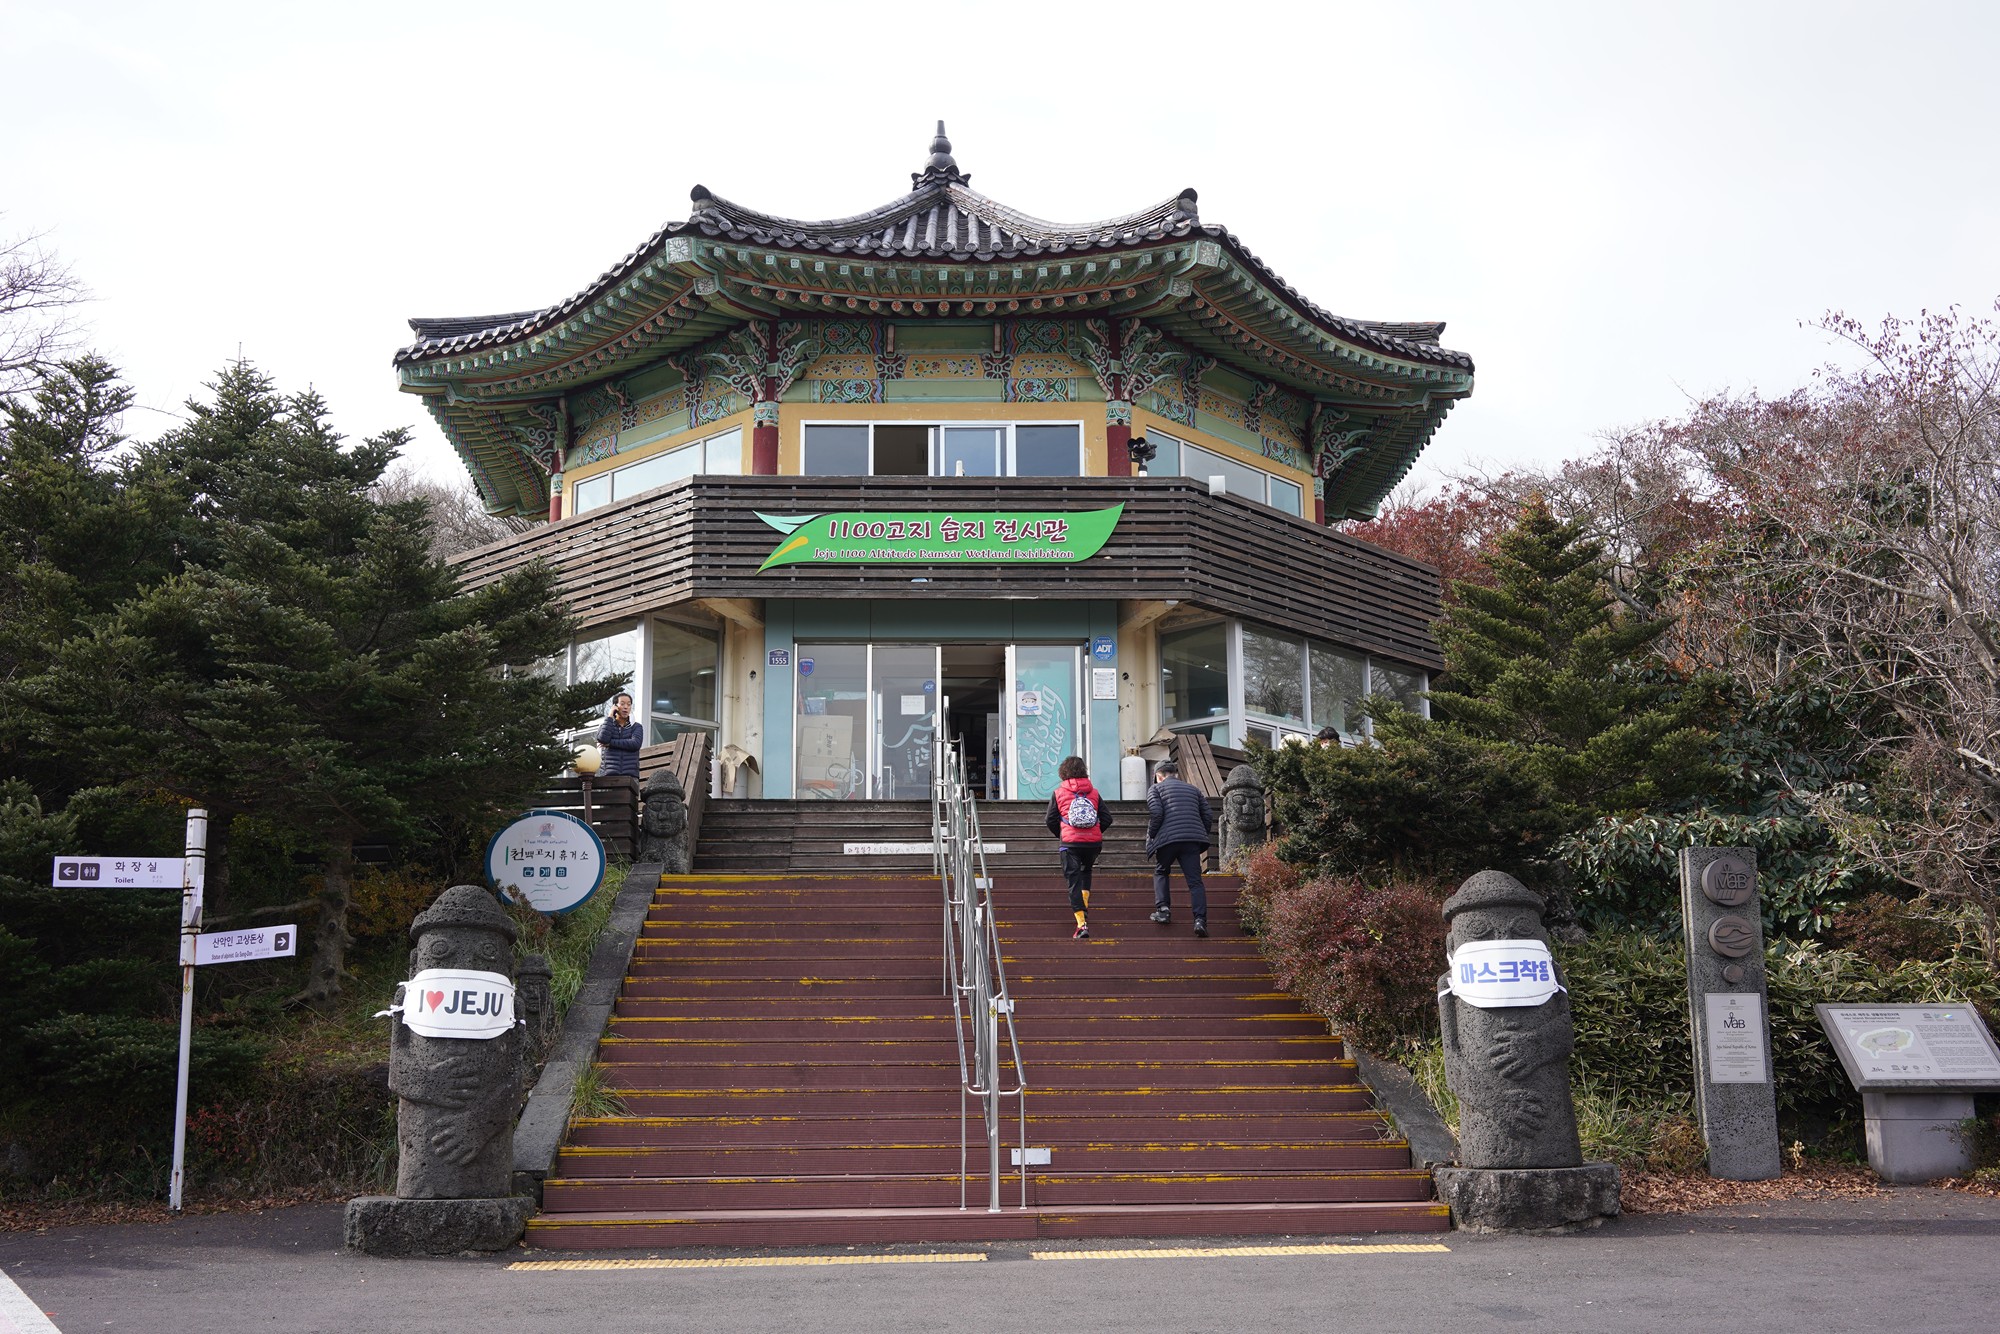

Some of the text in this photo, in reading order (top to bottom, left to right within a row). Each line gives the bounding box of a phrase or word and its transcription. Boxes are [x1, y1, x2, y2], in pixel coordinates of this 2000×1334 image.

[829, 516, 1069, 542] 1100고지 습지 전시관
[813, 548, 1075, 560] Jeju 1100 Altitude Ramsar Wetland Exhibition
[1096, 644, 1112, 653] ADT
[772, 657, 787, 665] 1555
[212, 933, 264, 949] 산악인 고상돈상
[1460, 960, 1550, 984] 마스크착용
[418, 989, 504, 1017] I JEJU
